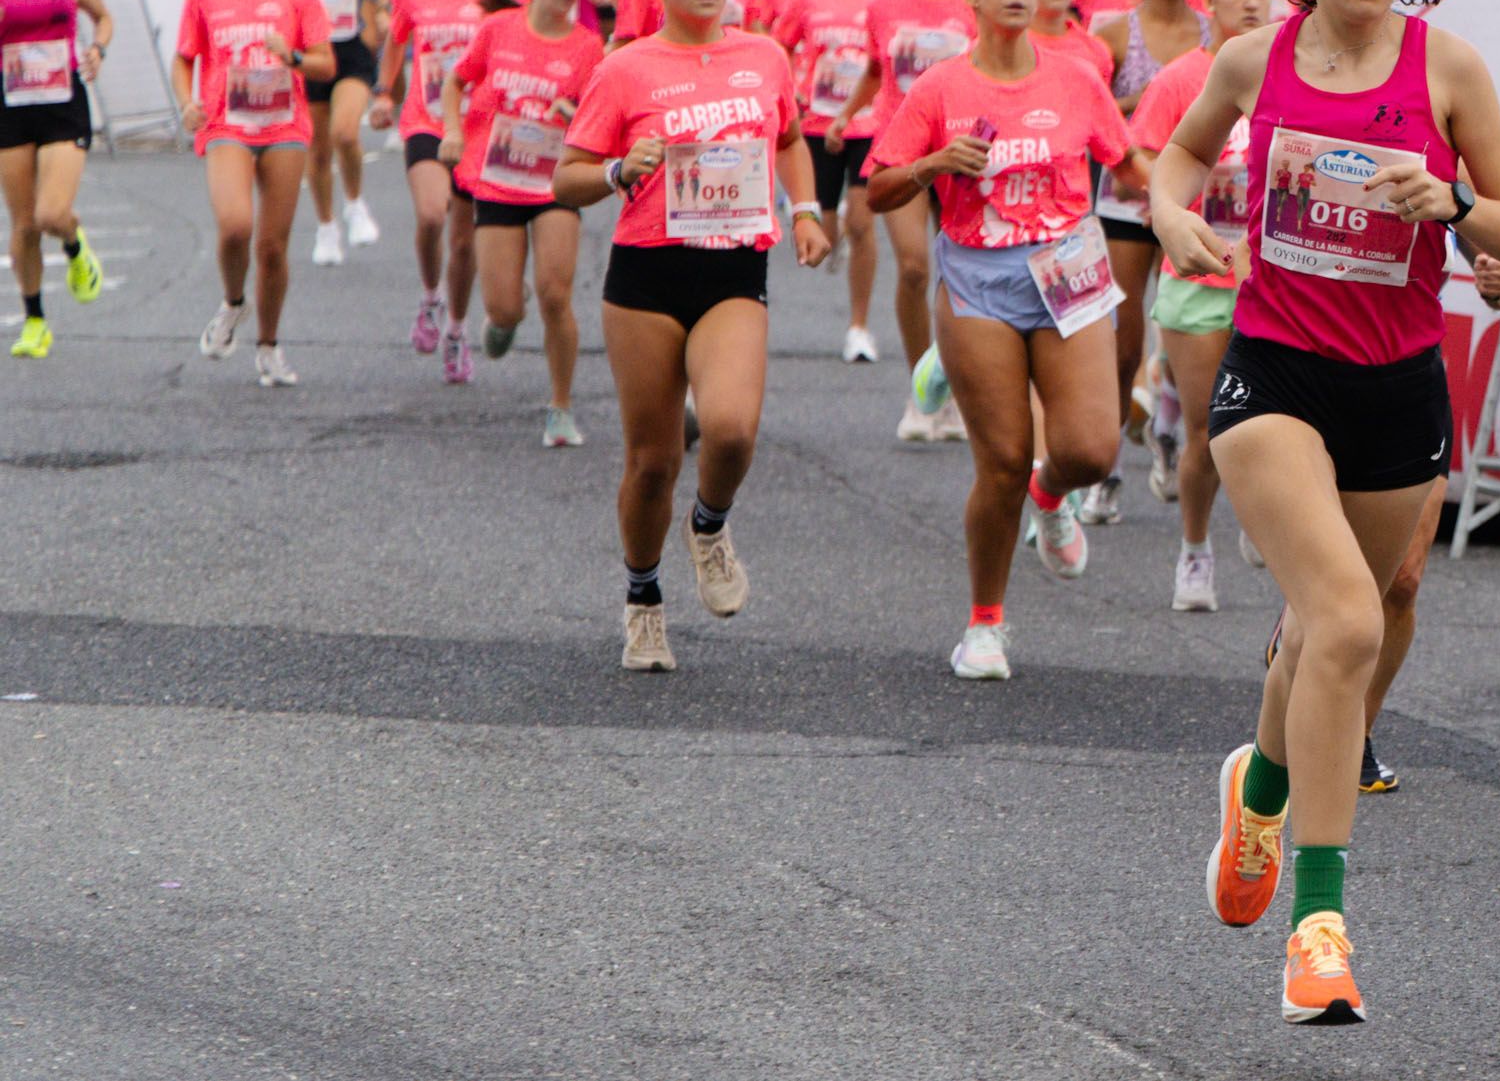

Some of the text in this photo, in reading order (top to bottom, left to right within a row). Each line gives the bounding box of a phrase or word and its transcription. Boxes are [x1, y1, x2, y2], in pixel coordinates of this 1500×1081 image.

[664, 96, 765, 137] CARRERA
[1283, 143, 1312, 157] SUMA
[702, 184, 739, 200] 016
[1310, 201, 1369, 231] 016
[1273, 230, 1303, 245] CARRERA
[1304, 238, 1314, 248] DE
[1315, 240, 1325, 251] LA
[1327, 243, 1353, 255] MUJER
[1274, 247, 1317, 267] OYSHO
[1069, 267, 1098, 293] 016
[1346, 265, 1391, 278] Santander
